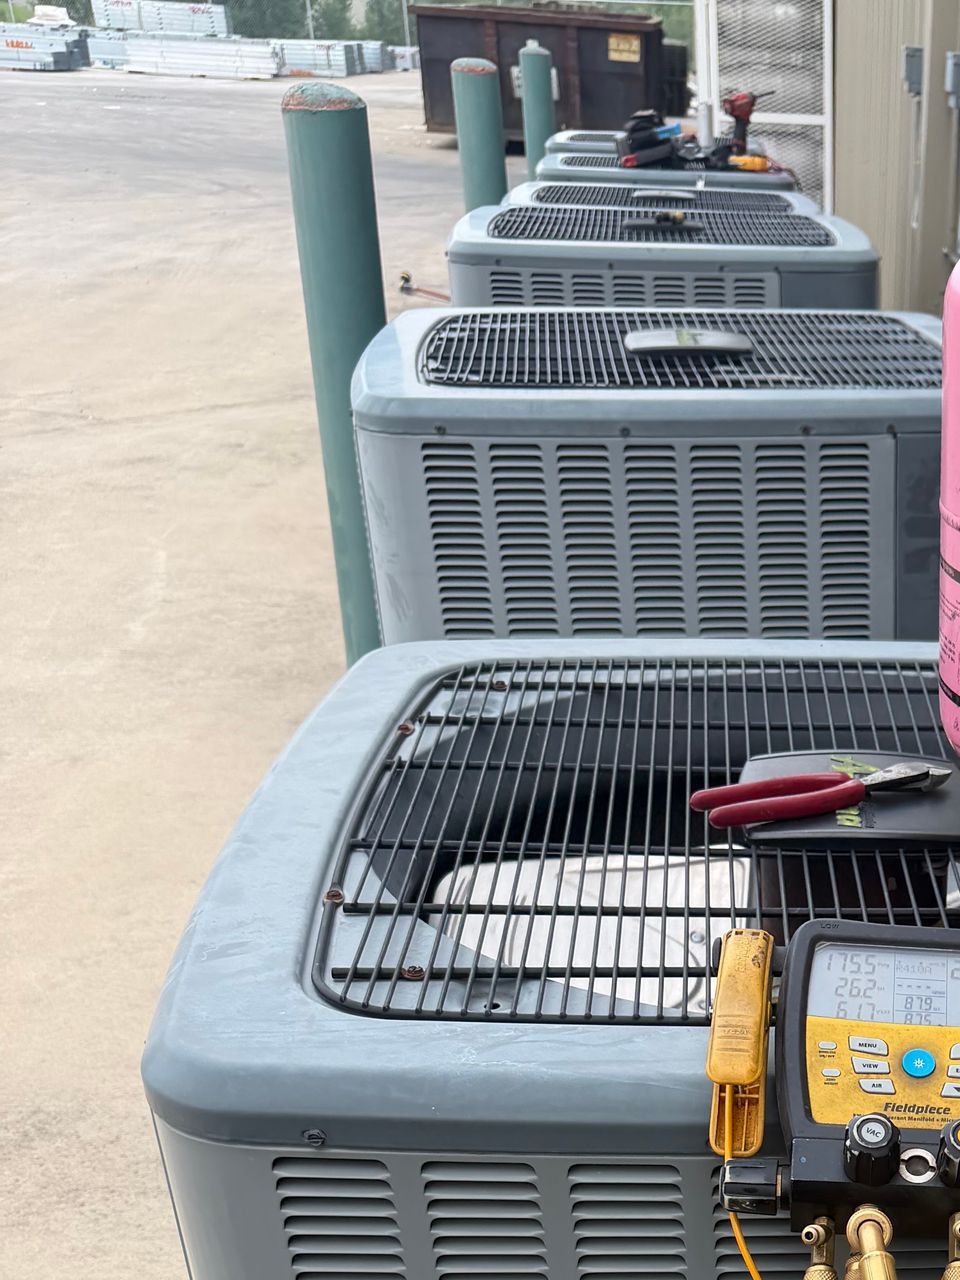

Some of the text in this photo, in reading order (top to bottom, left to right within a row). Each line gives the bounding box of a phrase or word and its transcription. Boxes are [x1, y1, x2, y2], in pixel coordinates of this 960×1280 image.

[827, 952, 876, 975] 175.5
[834, 977, 878, 999] 26.2
[883, 1102, 951, 1115] Fieldpiece
[907, 1115, 935, 1123] Manifold
[866, 1127, 882, 1138] VAC
